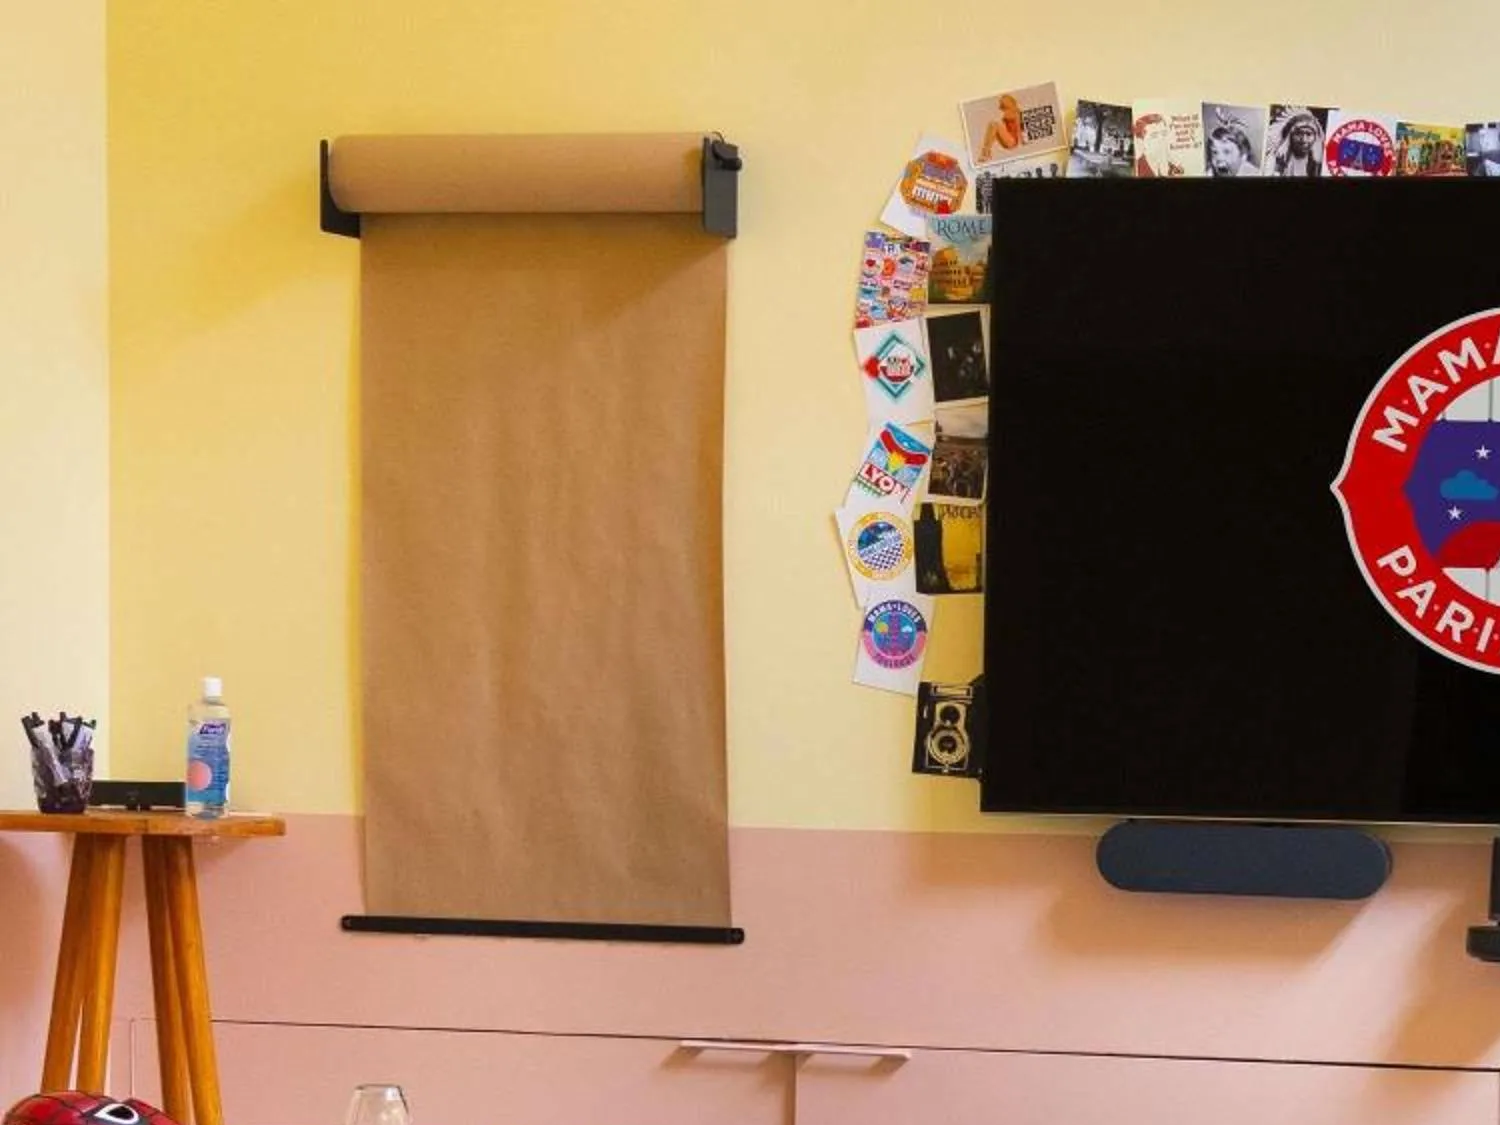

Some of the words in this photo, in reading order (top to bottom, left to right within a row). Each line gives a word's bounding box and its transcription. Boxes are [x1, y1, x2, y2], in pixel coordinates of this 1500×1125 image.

[1334, 122, 1365, 143] MAMA
[936, 218, 988, 240] ROME
[860, 463, 910, 498] LYON
